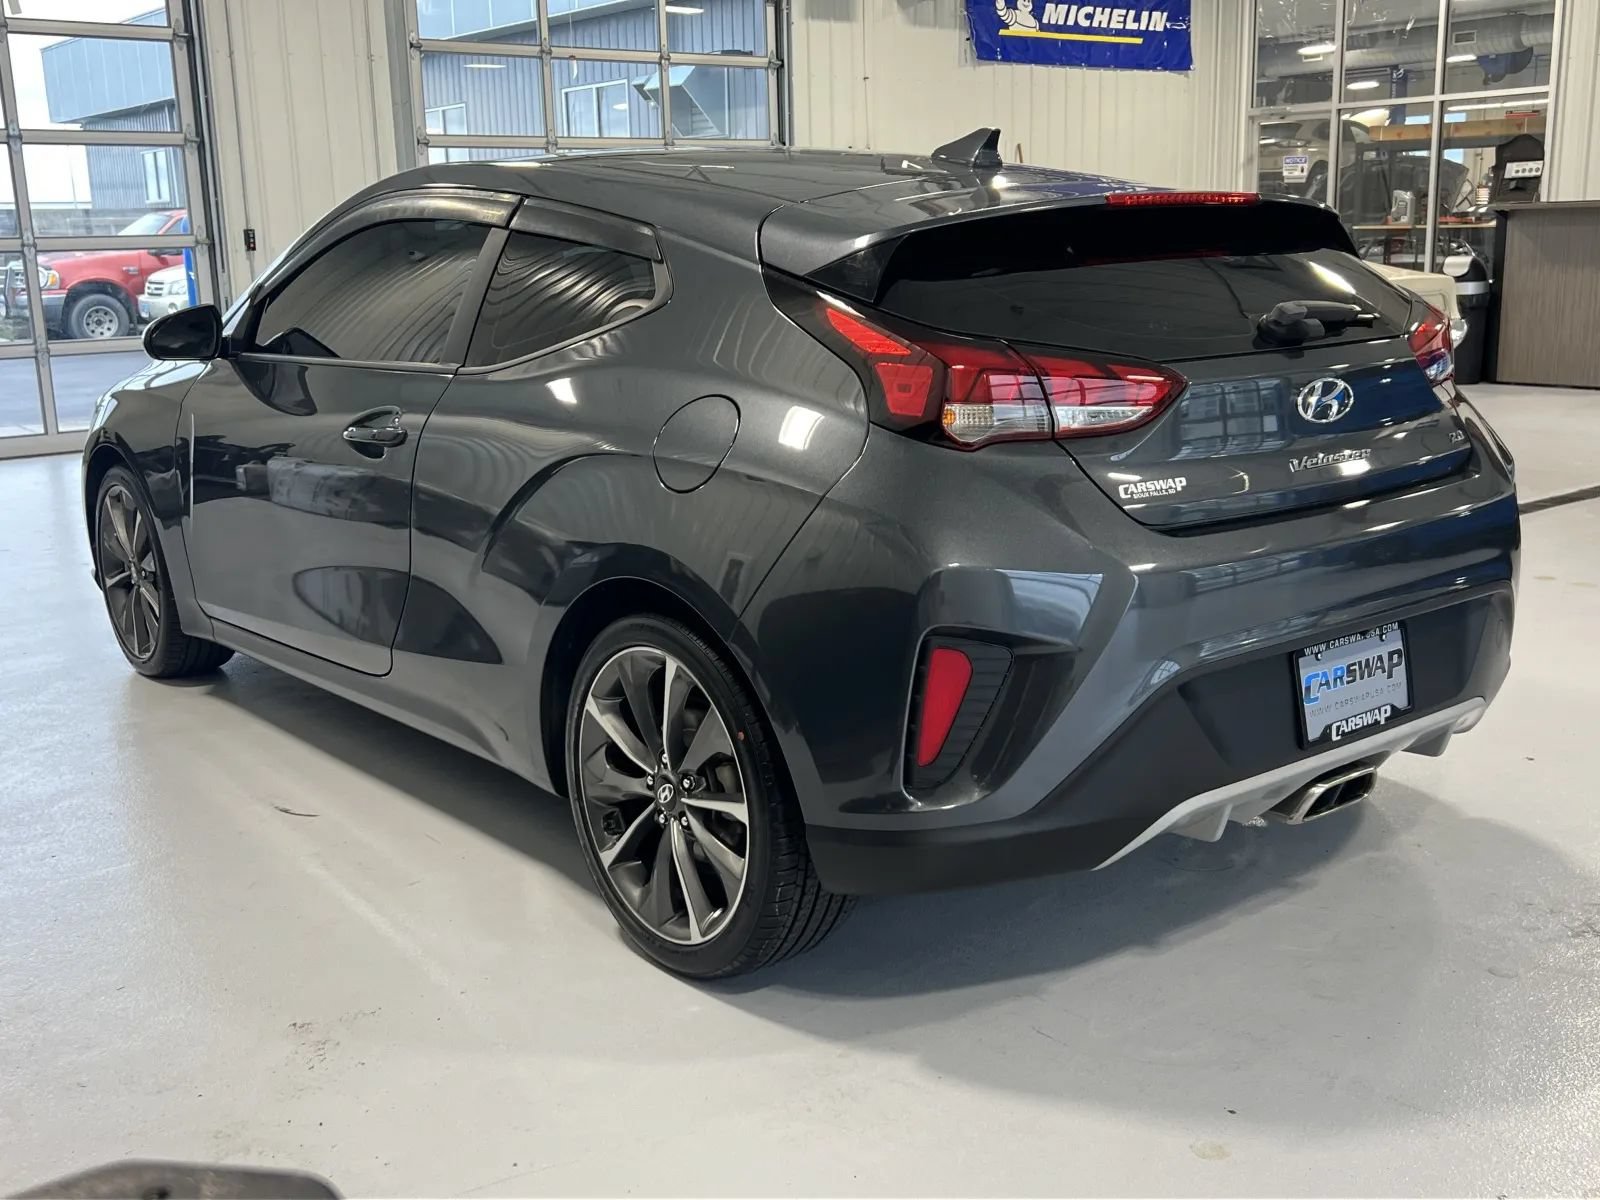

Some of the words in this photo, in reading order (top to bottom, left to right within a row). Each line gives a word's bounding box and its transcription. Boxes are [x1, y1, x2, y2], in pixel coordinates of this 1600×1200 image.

[1042, 3, 1168, 31] MICHELIN
[1118, 477, 1187, 499] CARSWAP
[1303, 647, 1403, 705] CARSWAP
[1331, 704, 1391, 741] CARSWAP
